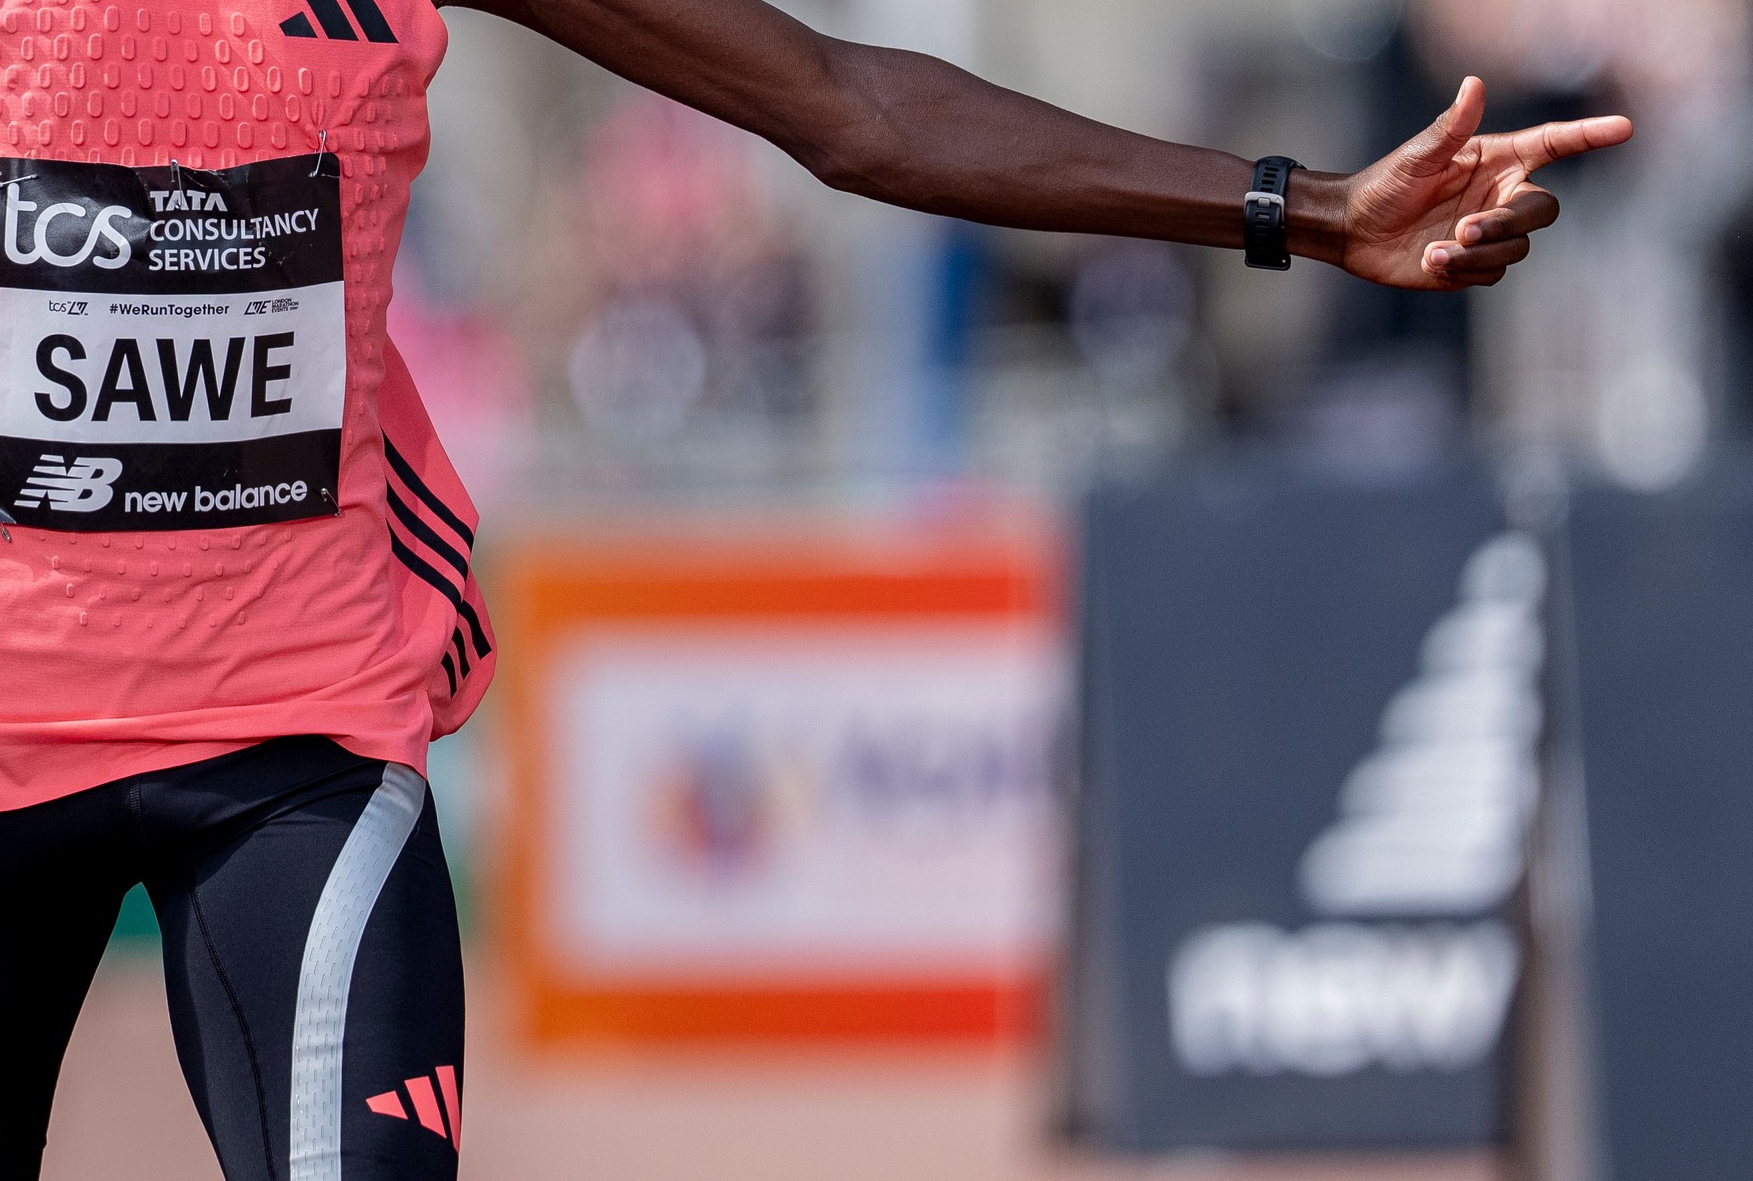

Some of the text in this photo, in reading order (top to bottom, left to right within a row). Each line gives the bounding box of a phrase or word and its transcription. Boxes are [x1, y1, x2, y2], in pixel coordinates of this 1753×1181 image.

[149, 190, 228, 212] TATA
[4, 183, 132, 269] tcs
[150, 208, 319, 241] CONSULTANCY
[149, 247, 266, 271] SERVICES
[109, 303, 230, 318] #WeRunTogether
[34, 331, 295, 422] SAWE
[124, 480, 308, 512] new balance
